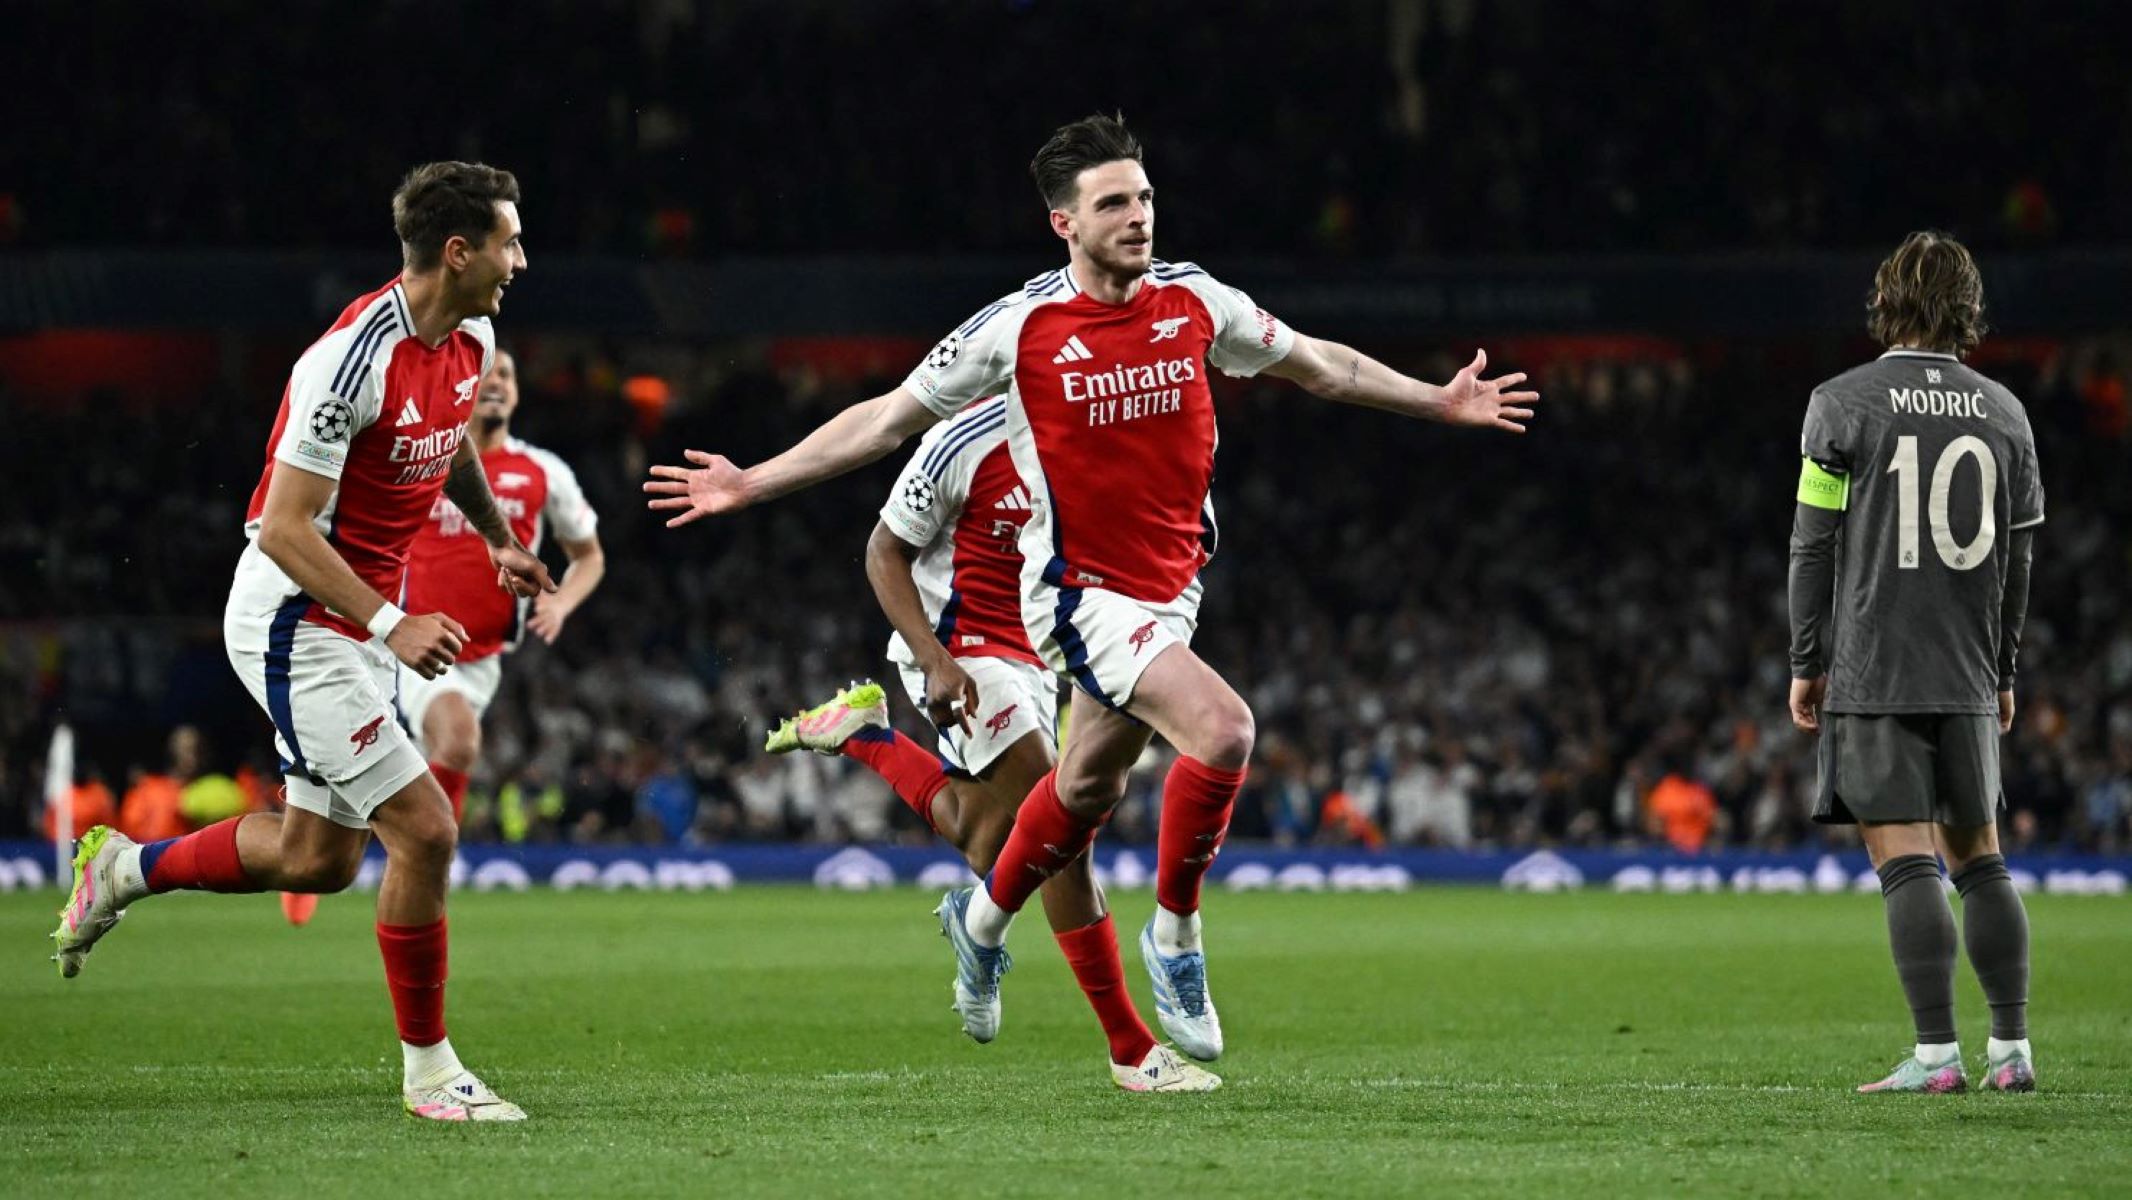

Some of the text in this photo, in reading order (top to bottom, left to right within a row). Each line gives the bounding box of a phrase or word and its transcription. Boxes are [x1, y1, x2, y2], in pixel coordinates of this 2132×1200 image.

[1060, 357, 1195, 402] Emirates
[1089, 388, 1181, 427] FLY BETTER
[1888, 388, 1987, 418] MODRIĆ
[1886, 435, 1997, 571] 10
